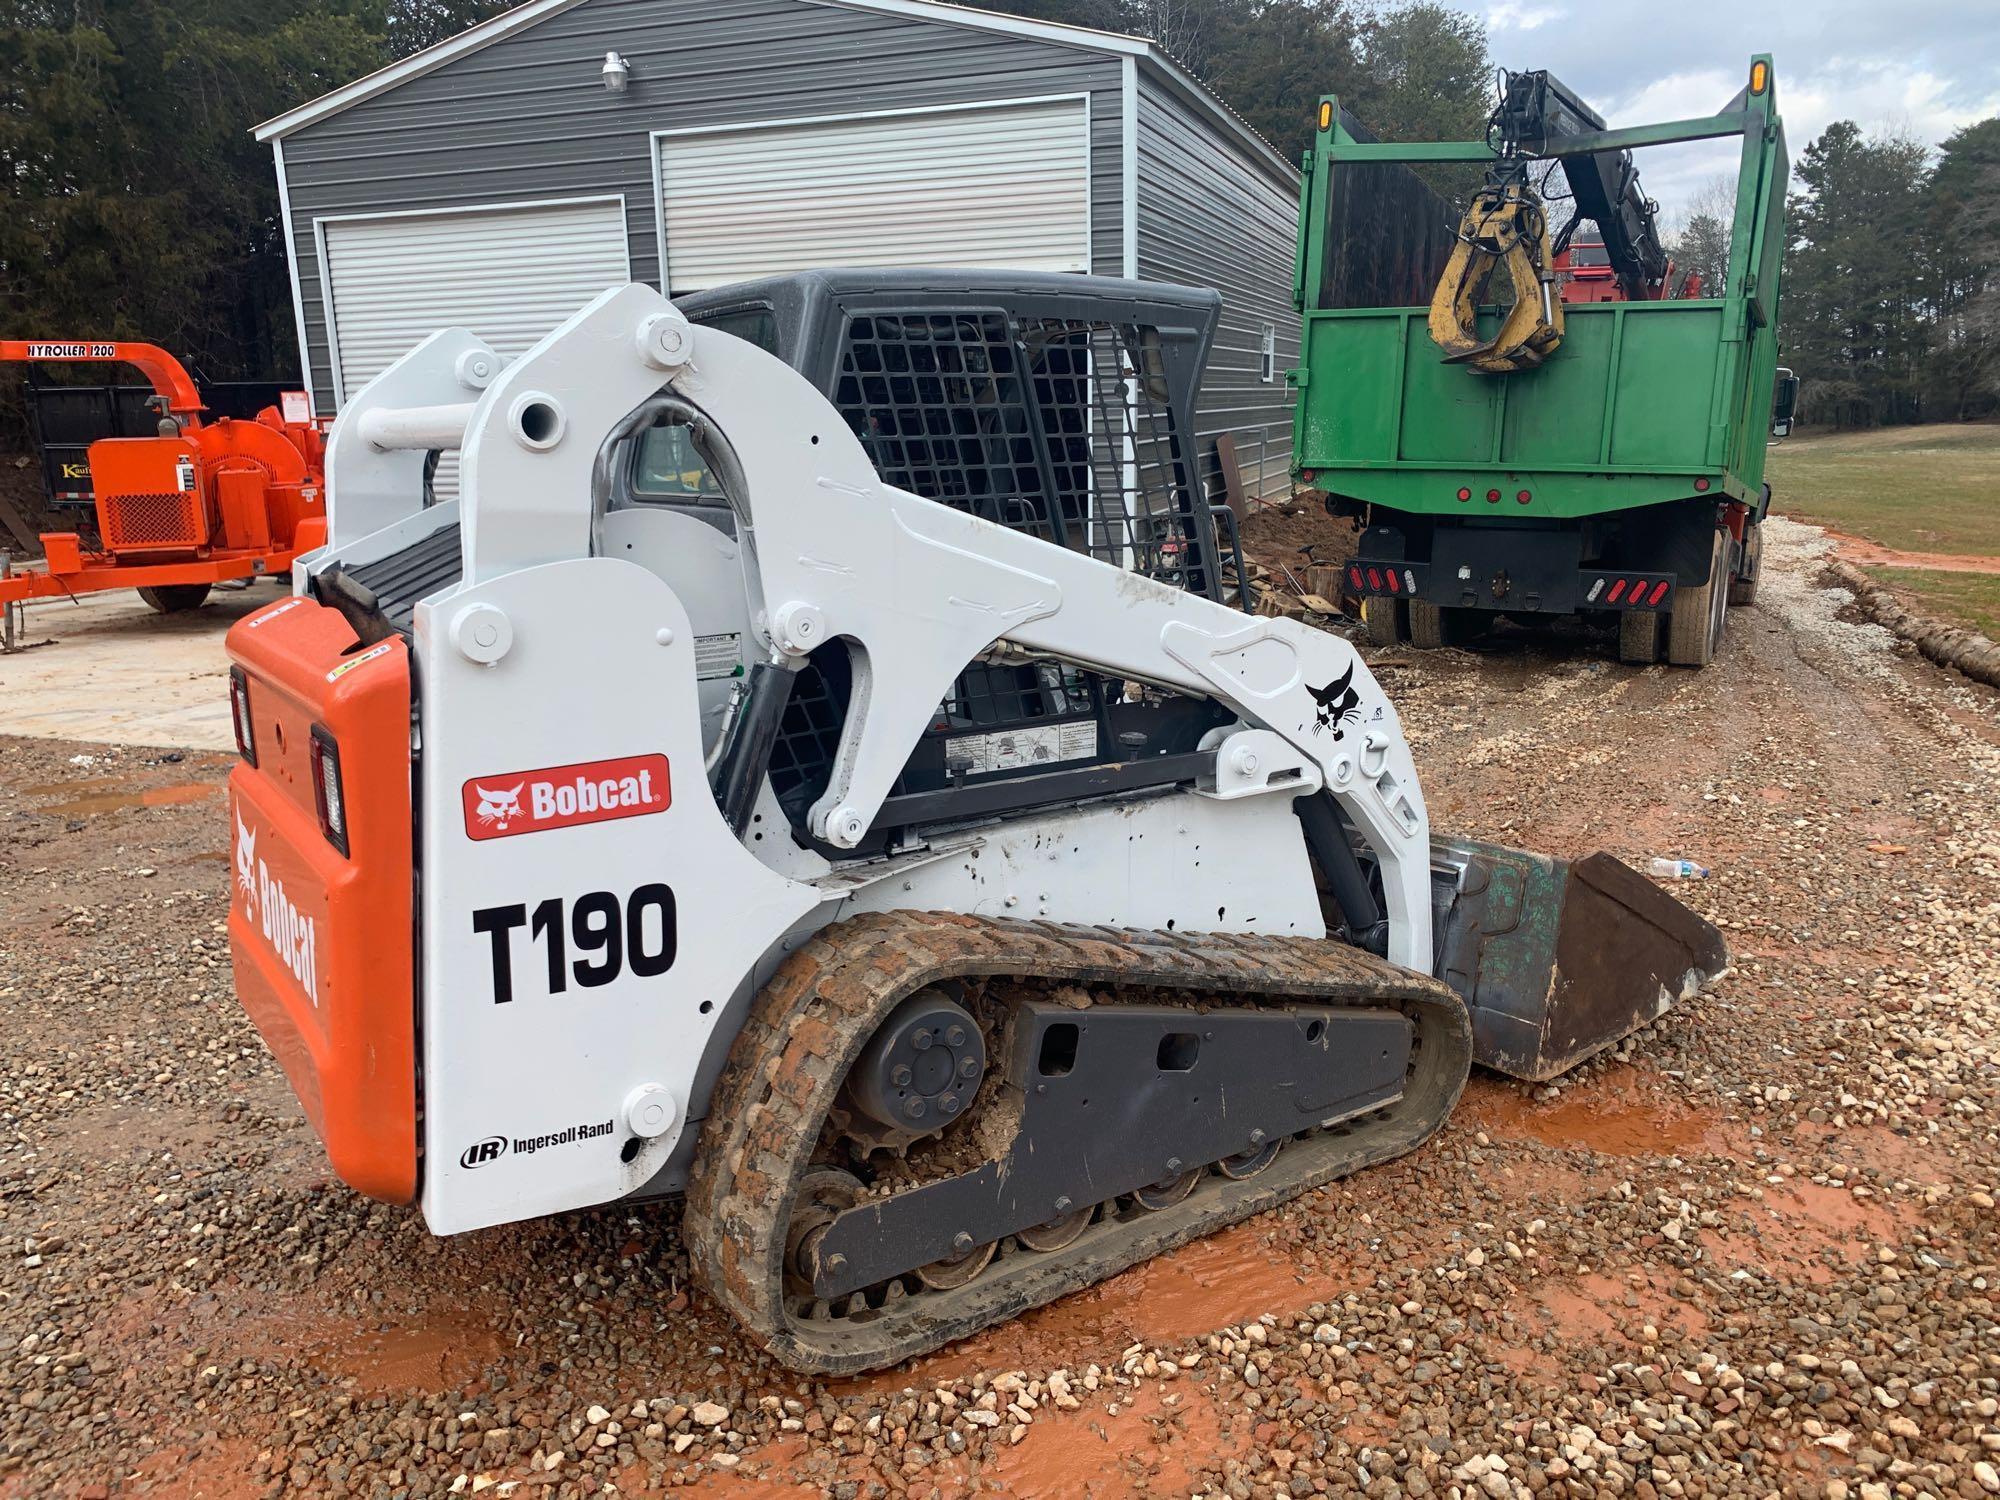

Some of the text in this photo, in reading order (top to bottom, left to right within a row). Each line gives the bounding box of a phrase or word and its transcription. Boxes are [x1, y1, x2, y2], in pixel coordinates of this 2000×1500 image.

[90, 345, 115, 357] 1200
[61, 464, 92, 478] Kauf
[531, 769, 653, 820] Bobcat
[258, 857, 319, 1009] Bobcat
[472, 883, 678, 1005] T190
